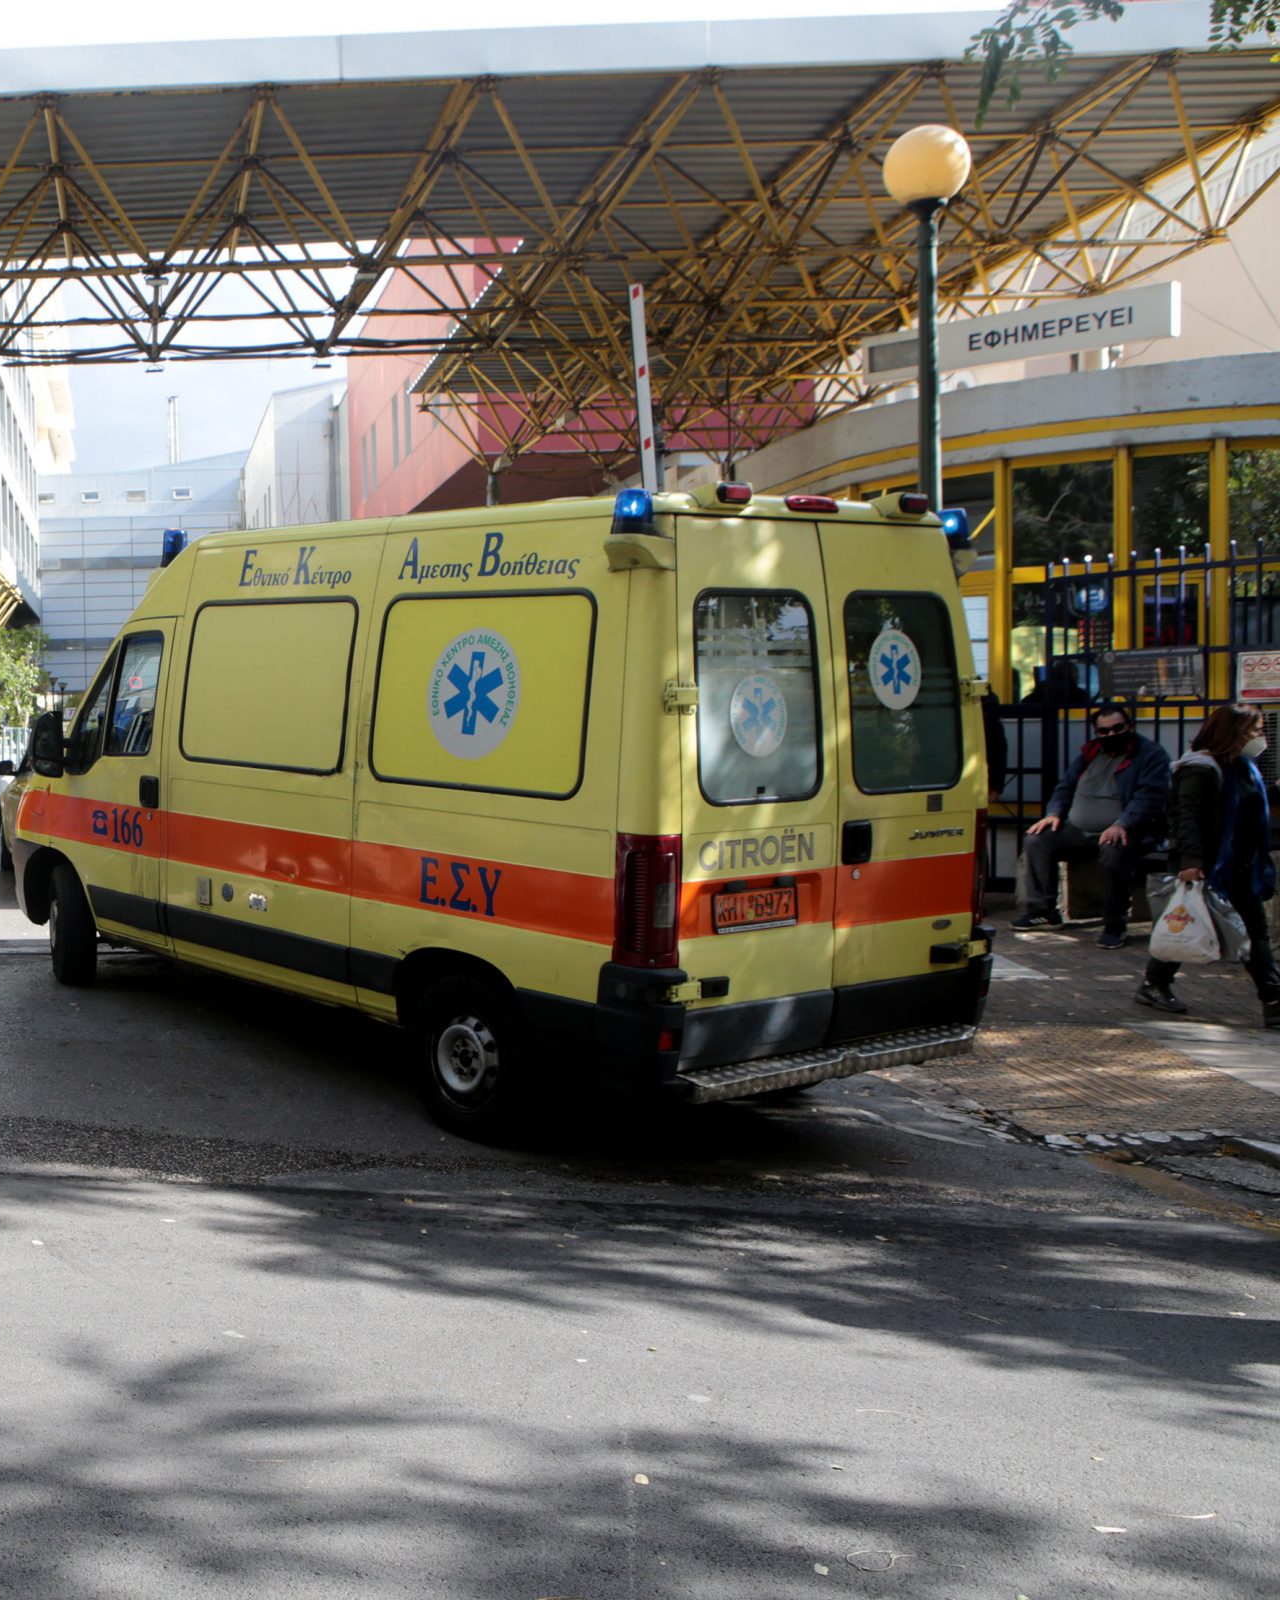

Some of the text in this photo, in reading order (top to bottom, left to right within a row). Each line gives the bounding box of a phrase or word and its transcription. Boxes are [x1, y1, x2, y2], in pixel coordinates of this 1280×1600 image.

[968, 305, 1133, 351] ΕΦΗΜΕΡΕΥΕΙ
[238, 550, 293, 587] Εθνικό
[293, 546, 352, 588] Κέντρο
[477, 532, 580, 580] Βοήθειας
[431, 634, 516, 728] ΕΘΝΙΚΟ ΚΕΝΤΡΟ ΑΜΕΣΗΣ ΒΟΗΘΕΙΑΣ
[111, 807, 144, 848] 166
[699, 828, 814, 871] CITROËN
